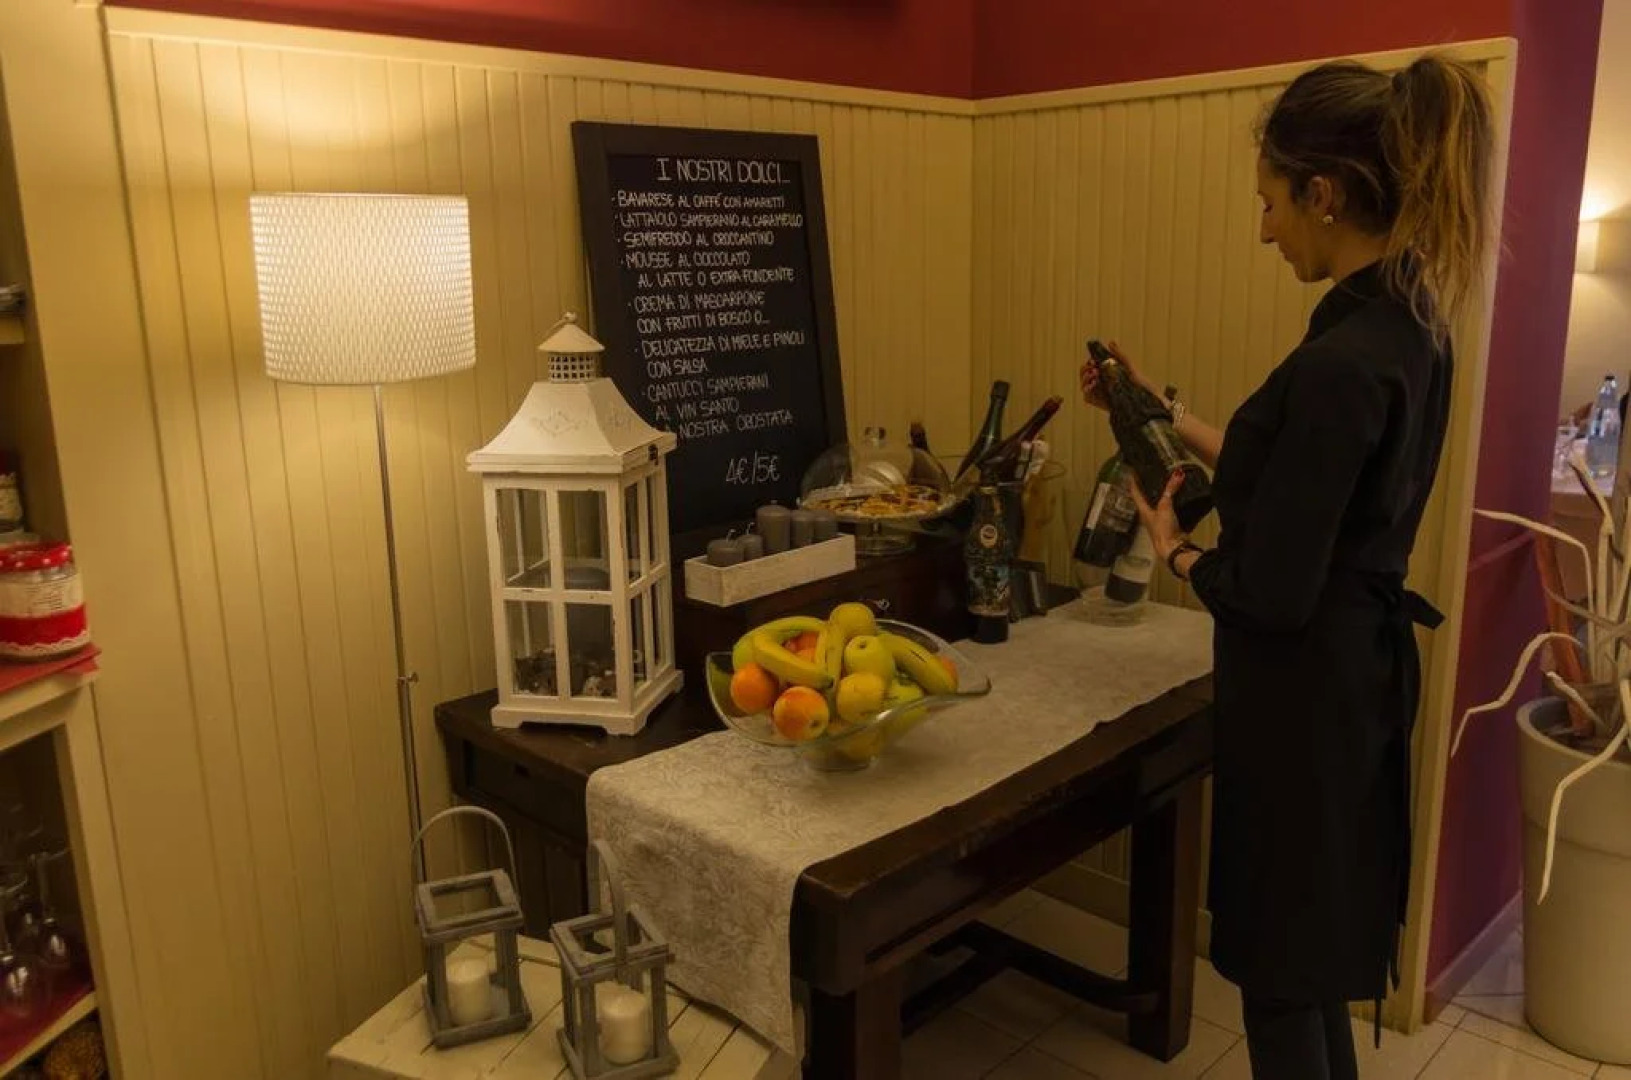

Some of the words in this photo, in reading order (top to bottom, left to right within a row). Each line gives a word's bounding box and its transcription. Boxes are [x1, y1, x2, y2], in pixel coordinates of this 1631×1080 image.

[656, 158, 672, 181] I
[677, 160, 732, 182] NOSTRI
[618, 190, 675, 208] BAVARESE
[678, 196, 691, 208] AL
[723, 197, 742, 208] CON
[744, 196, 784, 208] AMARETTI
[741, 215, 753, 226] AL
[753, 214, 803, 226] CARAMELLO
[623, 231, 691, 248] SEMIFREDDO
[696, 234, 709, 245] AL
[713, 231, 775, 245] CROCCANTINO
[626, 252, 672, 268] MOUSSE
[679, 254, 691, 267] AL
[693, 252, 750, 267] CIOCCOLATO
[638, 274, 653, 288] AL
[657, 272, 693, 287] LATTE
[697, 273, 706, 286] O
[710, 270, 743, 285] EXTRA
[743, 267, 795, 283] FONDENTE
[634, 294, 675, 313] CREMA
[678, 294, 691, 309] DI
[694, 291, 765, 309] MASCARPONE
[636, 317, 662, 334] CON
[665, 314, 700, 331] FRUTTI
[706, 314, 716, 327] DI
[719, 311, 750, 325] BOSCO
[642, 337, 715, 359] DELICATEZZA
[718, 335, 729, 352] DI
[731, 334, 763, 350] MIELE
[763, 335, 771, 347] E
[774, 331, 805, 347] PINOLI
[648, 362, 672, 379] CON
[674, 358, 709, 374] SALSA
[648, 381, 704, 402] CANTUCCI
[656, 405, 670, 421] AL
[677, 404, 697, 421] VIN
[700, 397, 739, 417] SANTO
[679, 419, 729, 439] NOSTRA
[736, 409, 793, 431] CROSTATA
